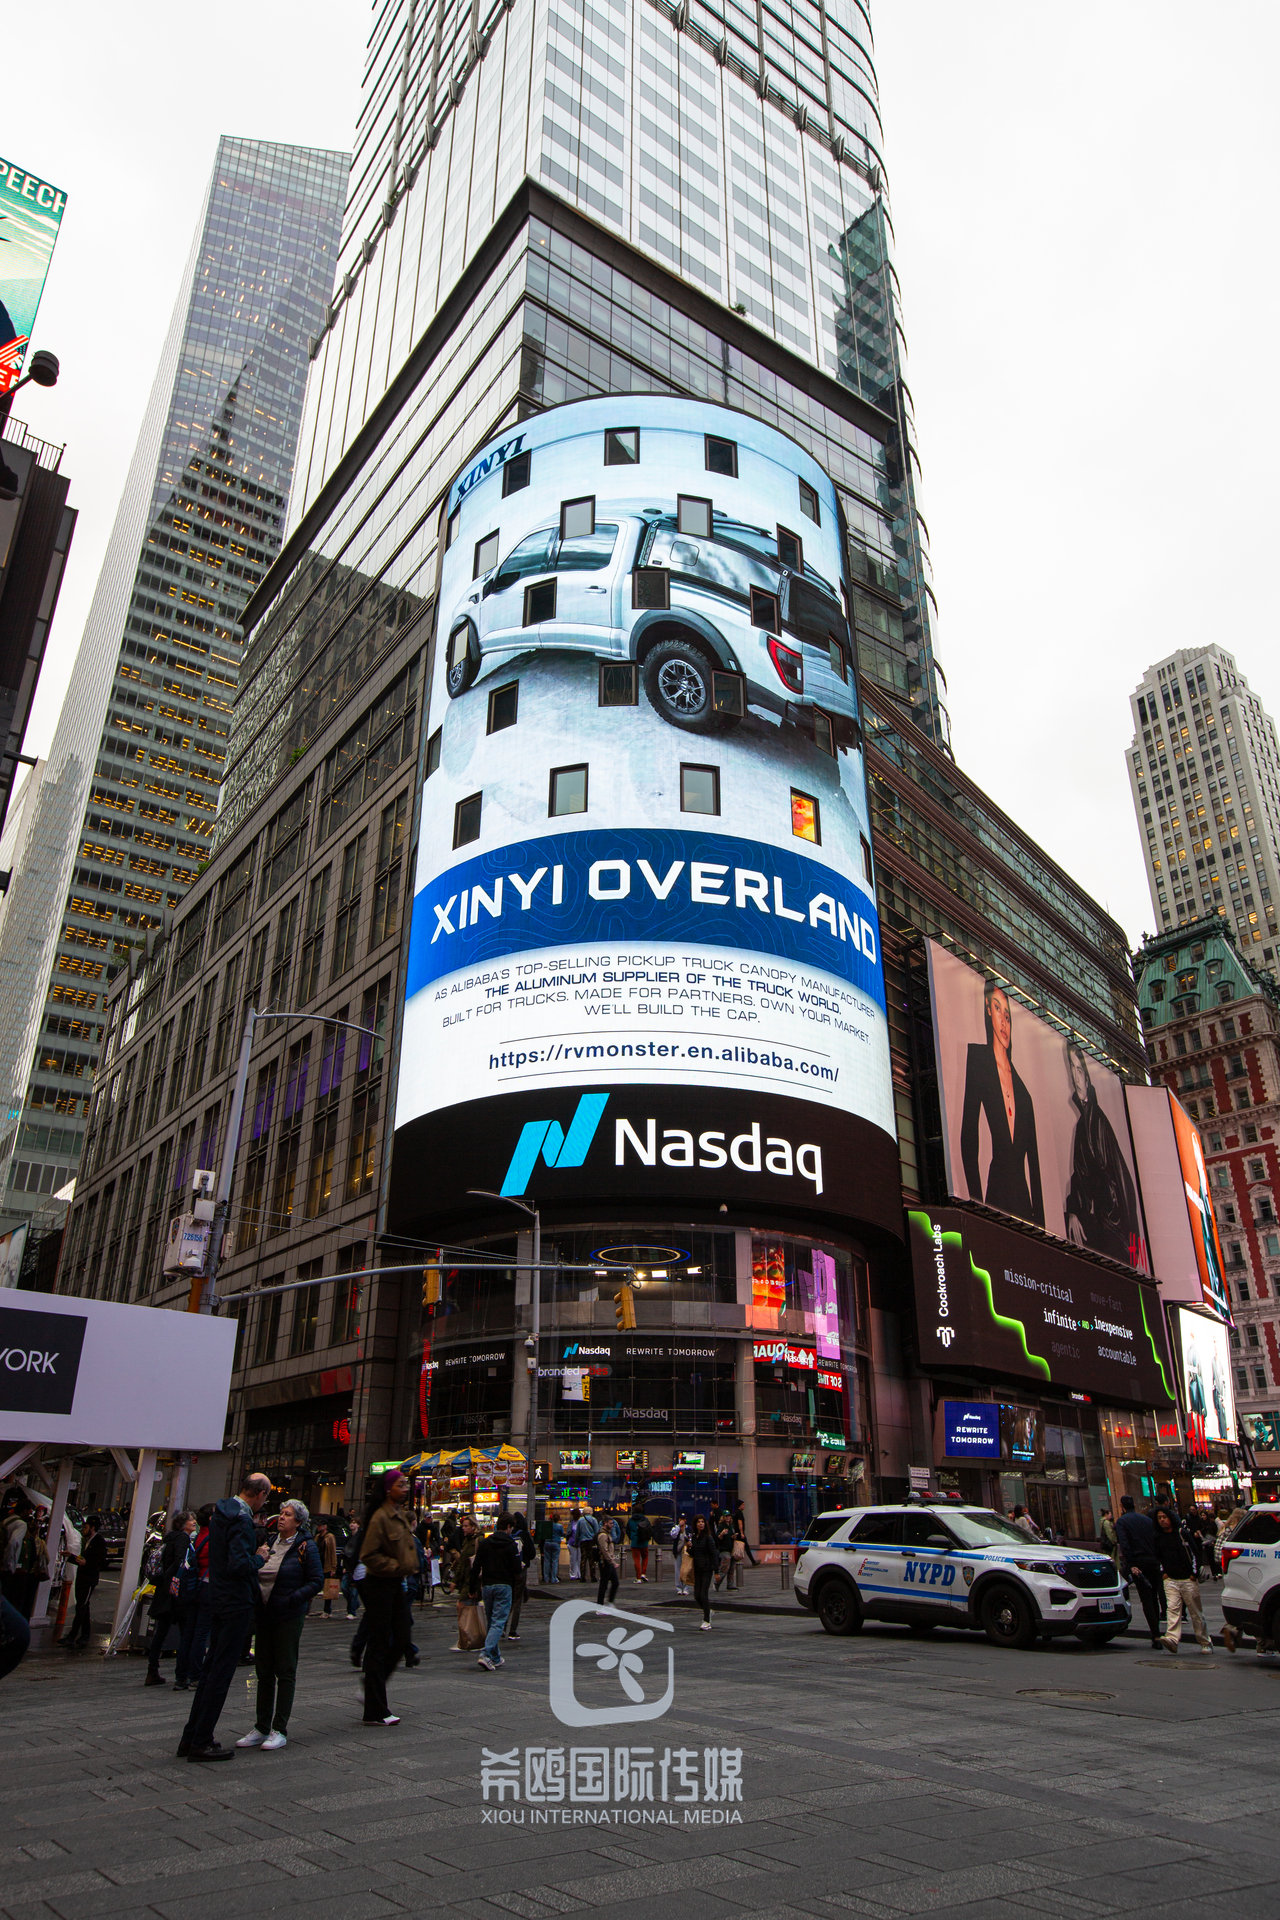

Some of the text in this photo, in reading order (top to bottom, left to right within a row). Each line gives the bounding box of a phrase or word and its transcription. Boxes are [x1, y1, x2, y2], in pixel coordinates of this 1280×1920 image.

[454, 432, 527, 507] XINYI
[430, 859, 877, 965] XINYI OVERLAND
[434, 955, 876, 1019] AS ALIBABA'S TOP-SELLING PICKUP TRUCK CANOPY MANUFACTURER
[484, 971, 842, 1015] THE ALUMINUM SUPPLIER OF THE TRUCK WORLD.
[442, 987, 871, 1046] BUILT FOR TRUCKS. MADE FOR PARTNERS. OWN YOUR MARKET.
[584, 1004, 760, 1023] WE'LL BUILD THE CAP.
[489, 1041, 840, 1082] https://rvmonster.en.alibaba.com/
[615, 1118, 824, 1196] Nasdaq
[933, 1224, 949, 1317] Cockroach Labs
[1004, 1268, 1074, 1304] mission-critical
[1043, 1307, 1077, 1331] infinite
[1093, 1315, 1134, 1340] inexpensive
[445, 1357, 467, 1367] REWRITE
[579, 1346, 716, 1357] Nasdaq REWRITE TOMORROW
[1051, 1341, 1081, 1360] agentic
[1097, 1344, 1137, 1366] accountable
[623, 1407, 669, 1421] Nasdaq
[951, 1436, 994, 1445] TOMORROW
[956, 1426, 988, 1434] REWRITE
[983, 1555, 1006, 1563] POLICE
[903, 1561, 956, 1587] NYPD
